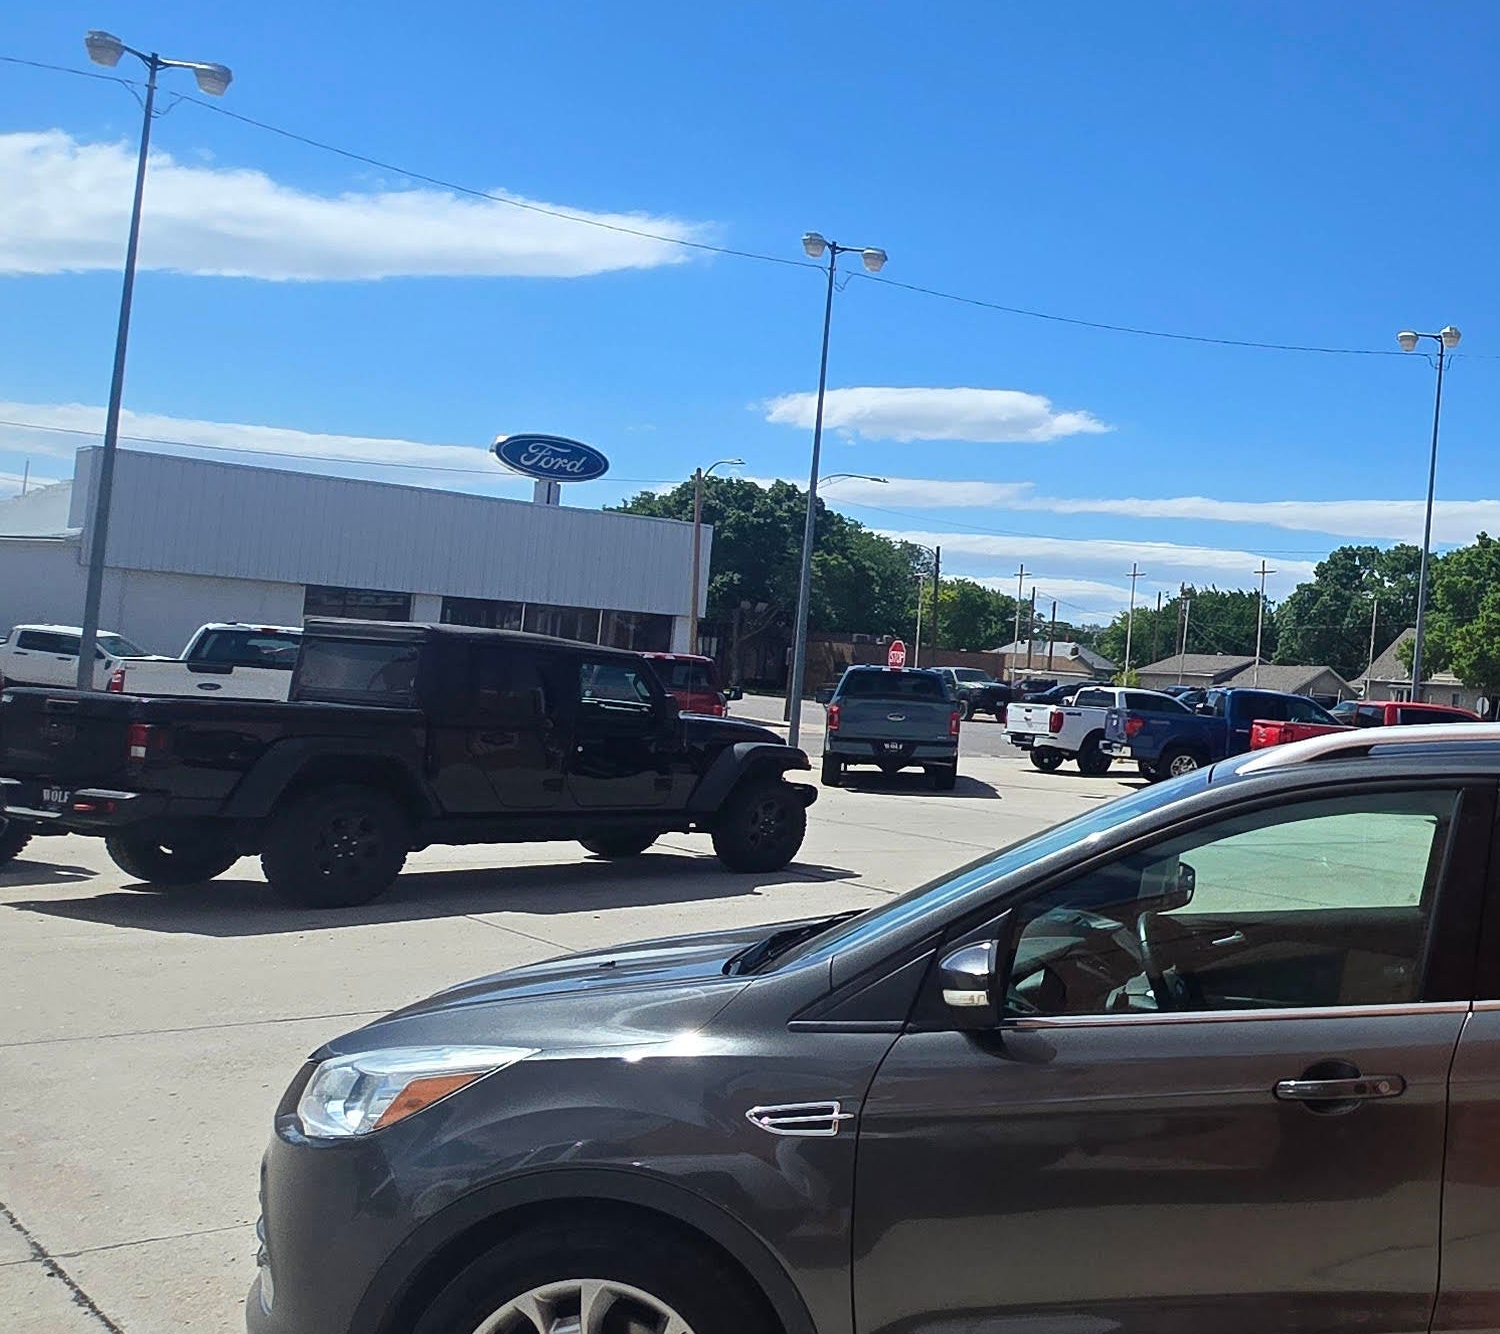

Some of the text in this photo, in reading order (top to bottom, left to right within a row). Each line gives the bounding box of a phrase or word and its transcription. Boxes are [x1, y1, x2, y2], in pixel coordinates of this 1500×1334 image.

[520, 442, 587, 473] Ford
[889, 650, 904, 664] STOP
[42, 788, 71, 803] WOLF
